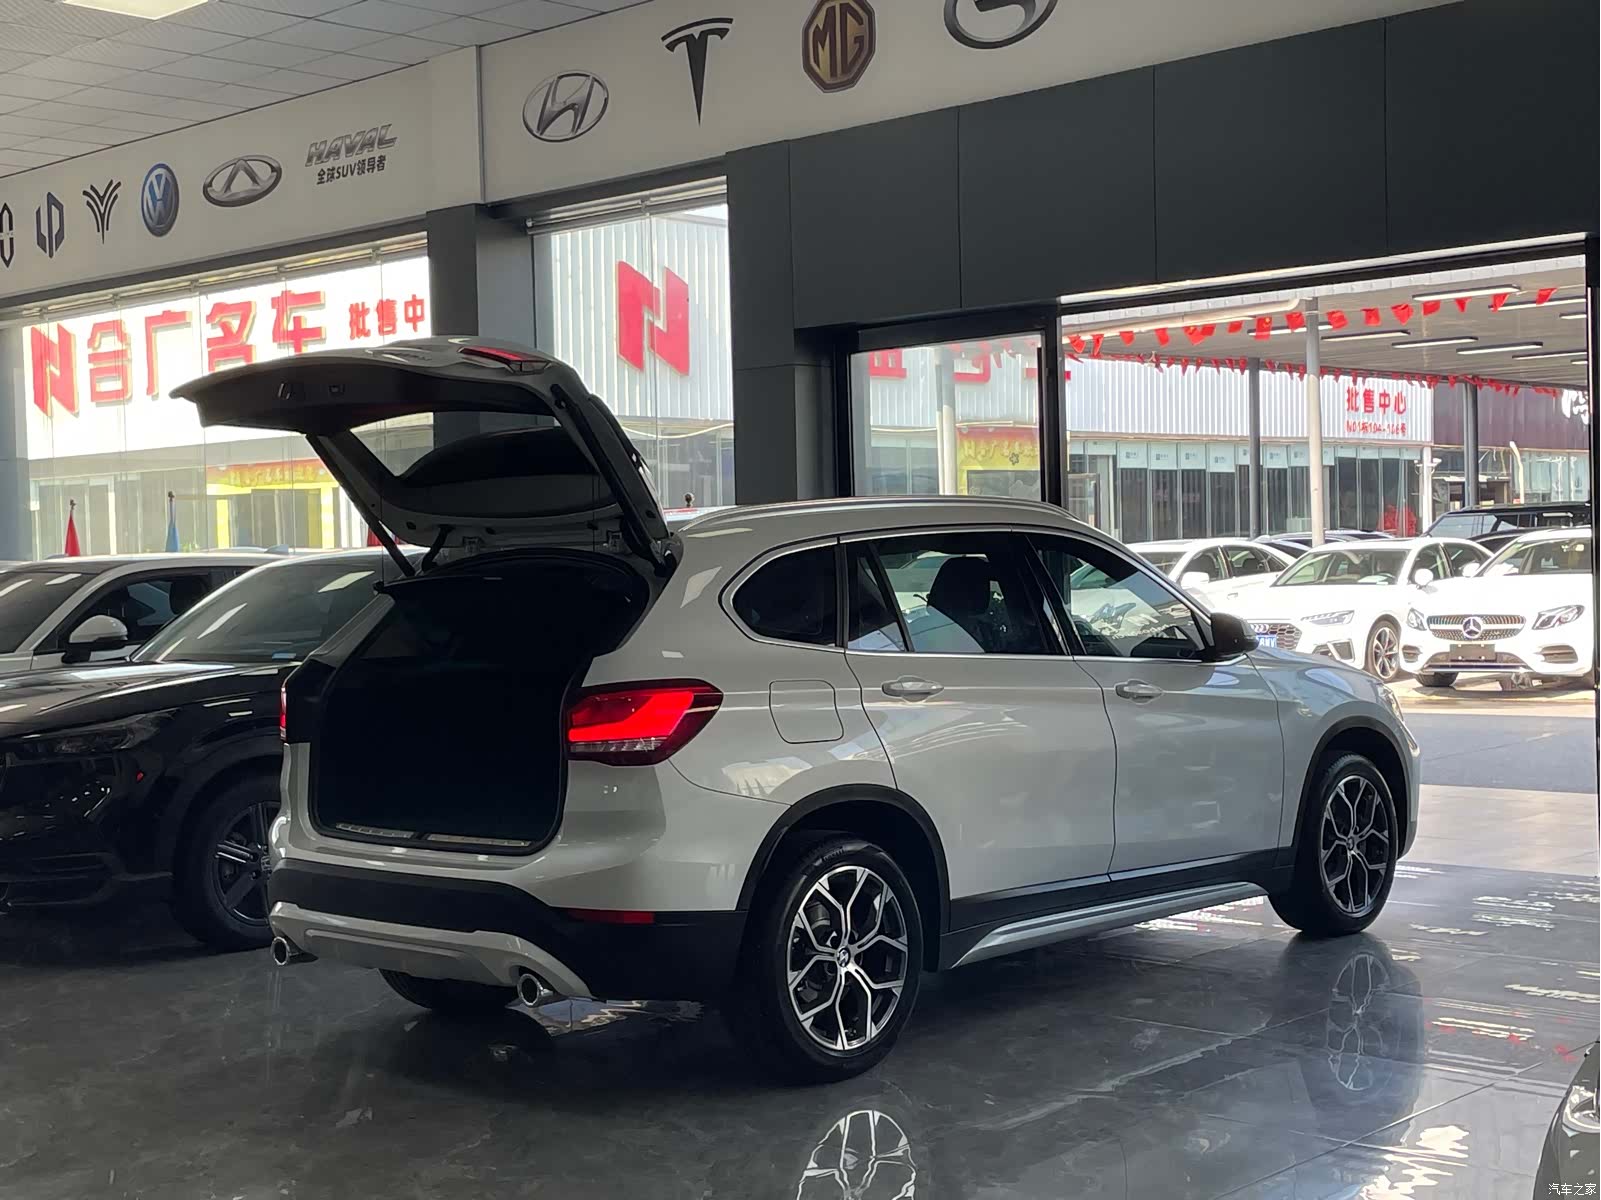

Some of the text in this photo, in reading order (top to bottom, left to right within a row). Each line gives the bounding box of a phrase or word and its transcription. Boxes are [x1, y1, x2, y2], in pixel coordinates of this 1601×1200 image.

[810, 2, 866, 79] MG
[304, 123, 398, 167] HAVAL
[316, 154, 387, 185] 全球SUV领导者
[1346, 386, 1407, 415] 批售中心
